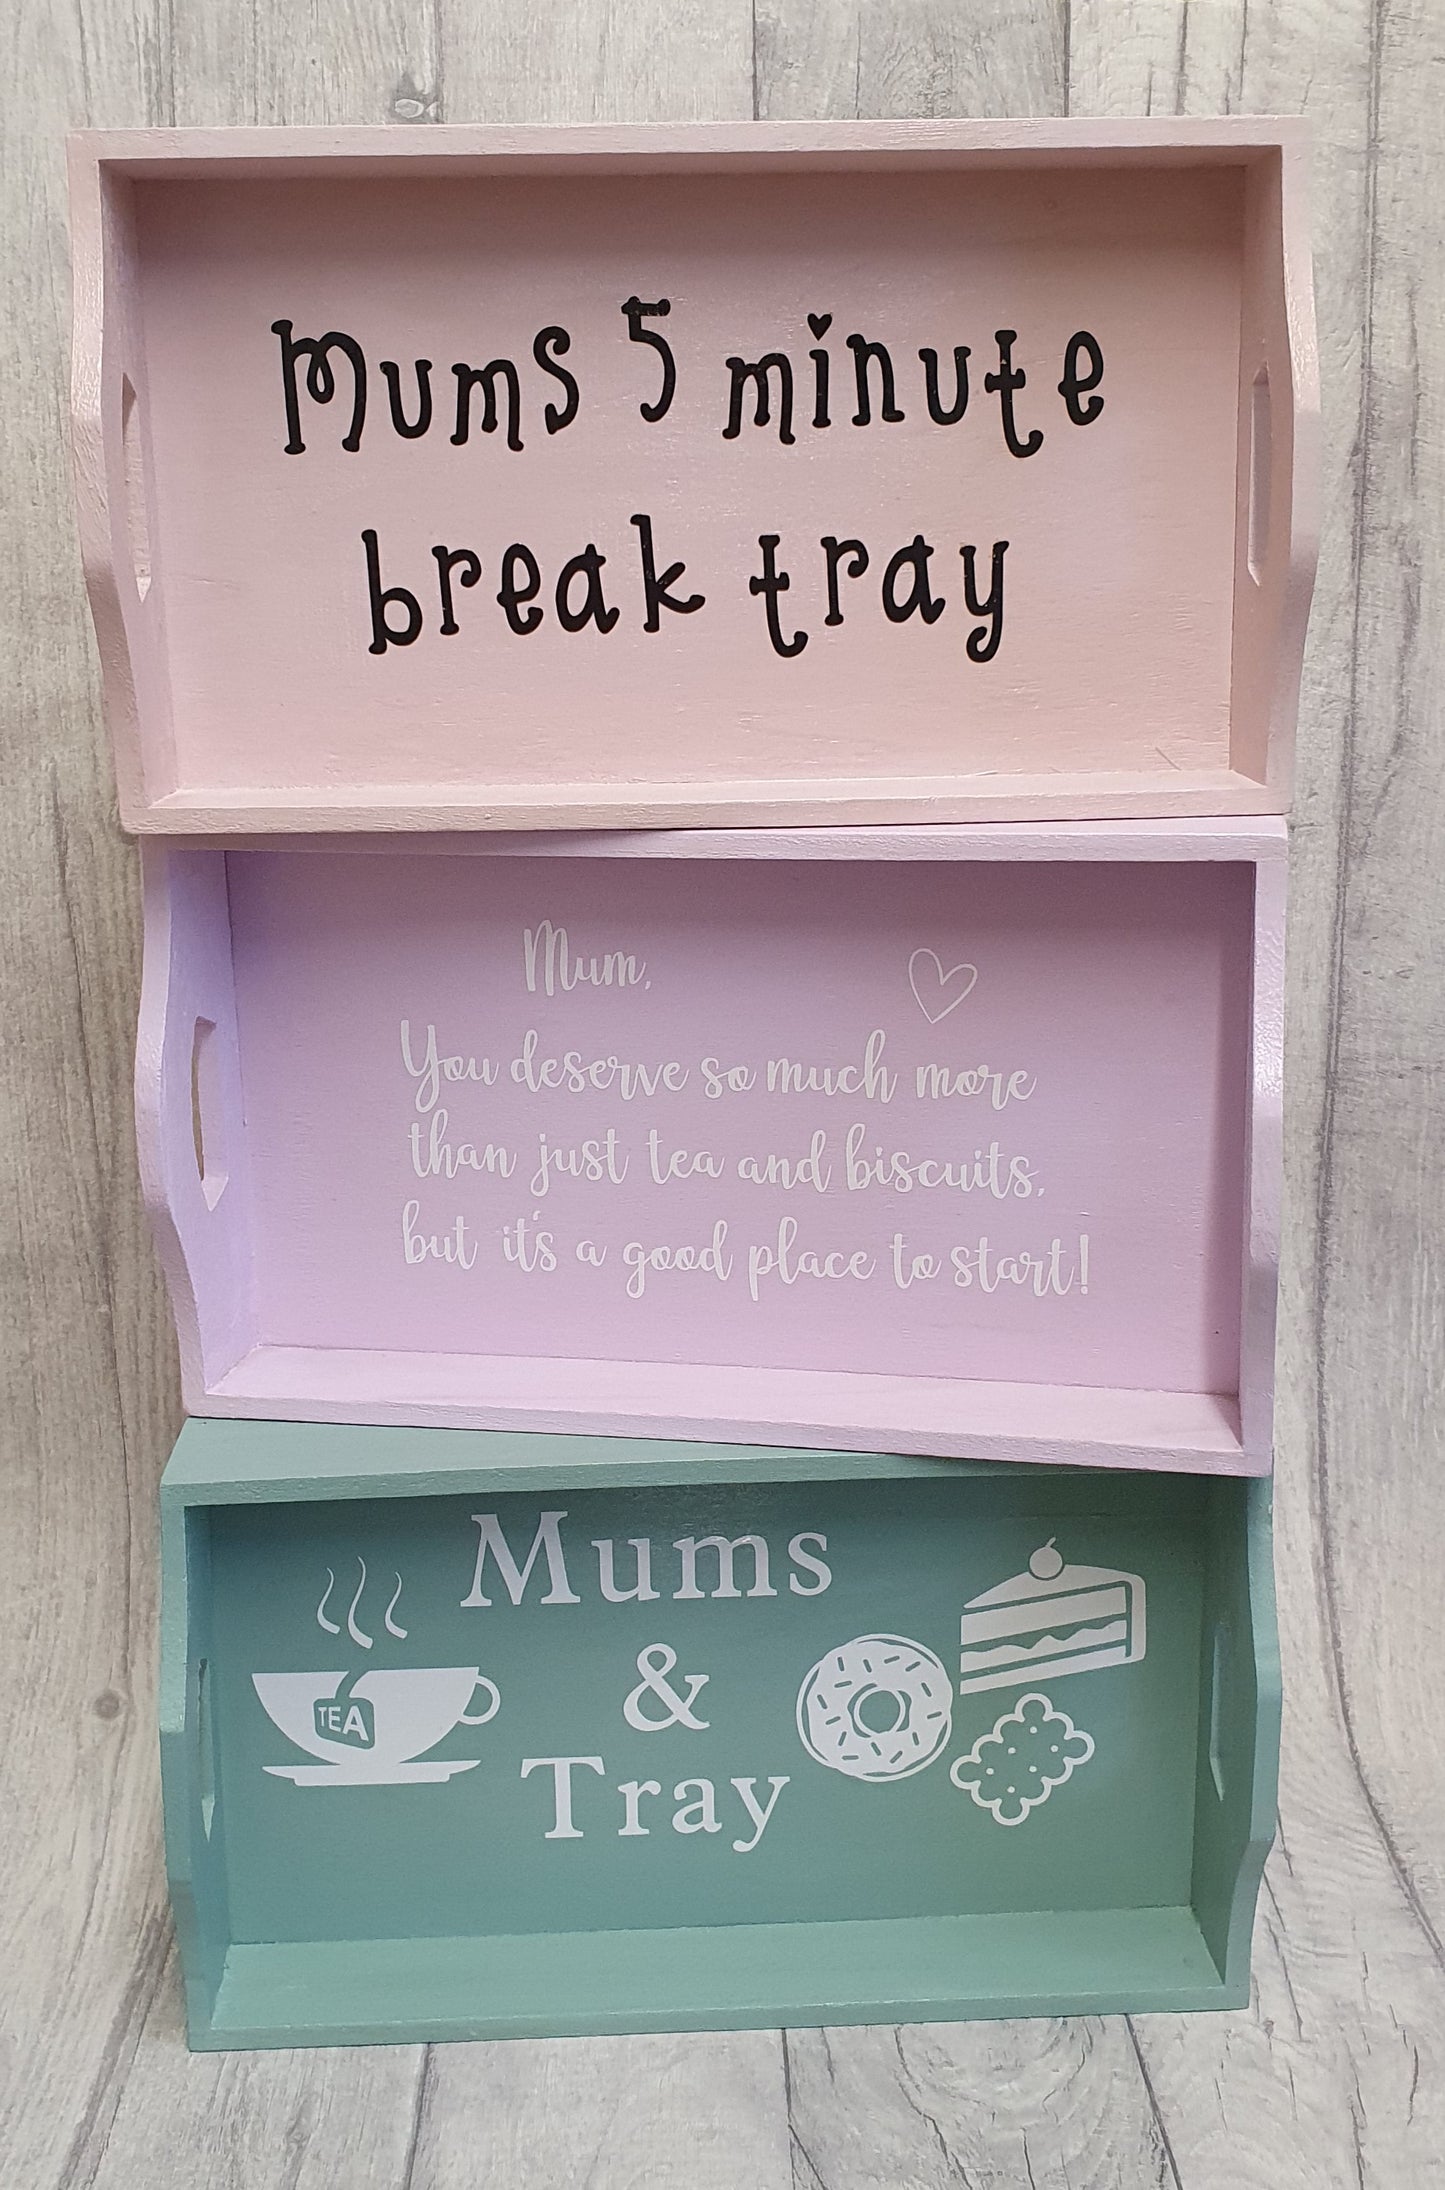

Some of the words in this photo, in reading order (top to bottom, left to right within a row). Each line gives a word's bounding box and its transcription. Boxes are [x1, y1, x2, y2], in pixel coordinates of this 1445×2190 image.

[271, 319, 580, 454] Mums
[621, 296, 677, 423] 5
[722, 312, 1105, 458] minute
[361, 513, 705, 654] break
[749, 534, 1010, 663] tray
[522, 919, 652, 997] Mum,
[400, 1019, 499, 1113] You
[510, 1030, 690, 1100] deserve
[700, 1057, 757, 1099] so
[766, 1029, 898, 1103] much
[915, 1063, 1037, 1110] more
[407, 1110, 517, 1179] than
[530, 1128, 629, 1197] just
[646, 1129, 726, 1185] tea
[737, 1130, 831, 1193] and
[845, 1124, 1047, 1199] biscuits,
[401, 1200, 478, 1271] but
[501, 1211, 557, 1273] it's
[576, 1238, 607, 1266] a
[623, 1221, 733, 1299] good
[748, 1217, 876, 1302] place
[889, 1234, 941, 1290] to
[950, 1235, 1090, 1298] start!
[460, 1510, 834, 1608] Mums
[318, 1701, 370, 1743] TEA
[623, 1643, 710, 1732] &
[521, 1756, 791, 1853] Tray
